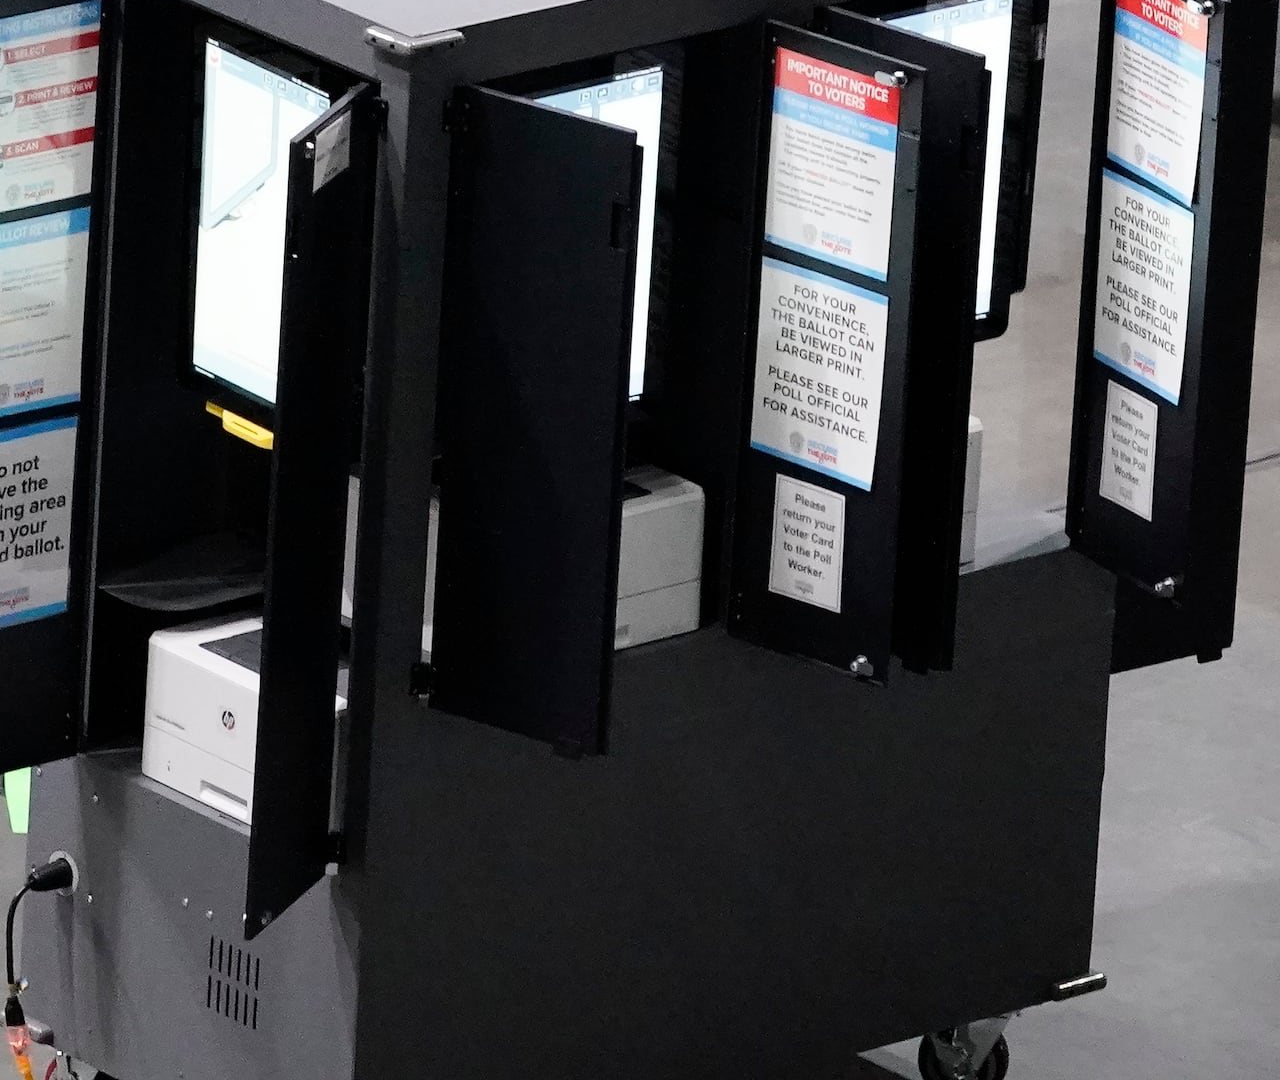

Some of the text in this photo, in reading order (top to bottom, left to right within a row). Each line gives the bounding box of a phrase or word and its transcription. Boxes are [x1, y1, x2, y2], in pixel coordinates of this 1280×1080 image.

[1140, 2, 1184, 36] TO VOTERS
[1171, 1, 1200, 30] NOTICE
[15, 45, 46, 59] SELECT
[27, 89, 51, 103] PRINT
[59, 80, 94, 97] REVIEW
[787, 58, 889, 103] IMPORTANT NOTICE
[808, 80, 866, 111] TO VOTERS
[15, 140, 39, 154] SCAN
[1126, 196, 1171, 227] FOR YOUR
[28, 219, 69, 238] REVIEW
[1109, 219, 1184, 266] THE BALLOT CAN
[1112, 251, 1146, 278] LARGER
[1116, 237, 1175, 277] BE VIEWED IN
[793, 284, 857, 315] FOR YOUR
[1106, 275, 1178, 323] PLEASE SEE OUR
[1102, 307, 1120, 326] FOR
[1110, 293, 1173, 336] POLL OFFICIAL
[771, 308, 875, 352] THE BALLOT CAN
[781, 326, 863, 364] BE VIEWED IN
[775, 340, 865, 381] LARGER PRINT.
[768, 365, 869, 409] PLEASE SEE OUR
[773, 382, 860, 422] POLL OFFICIAL
[1121, 399, 1143, 420] Please
[763, 397, 868, 444] FOR ASSISTANCE.
[1134, 427, 1150, 441] your
[1132, 440, 1148, 457] Card
[12, 455, 40, 474] not
[1120, 451, 1132, 465] the
[1132, 457, 1146, 472] Poll
[21, 477, 49, 494] the
[29, 495, 66, 514] area
[795, 493, 826, 513] Please
[9, 519, 48, 544] your
[783, 508, 836, 534] return your
[14, 536, 65, 560] ballot.
[783, 524, 834, 549] Voter Card
[783, 541, 832, 565] to the Poll
[787, 558, 826, 581] Worker.
